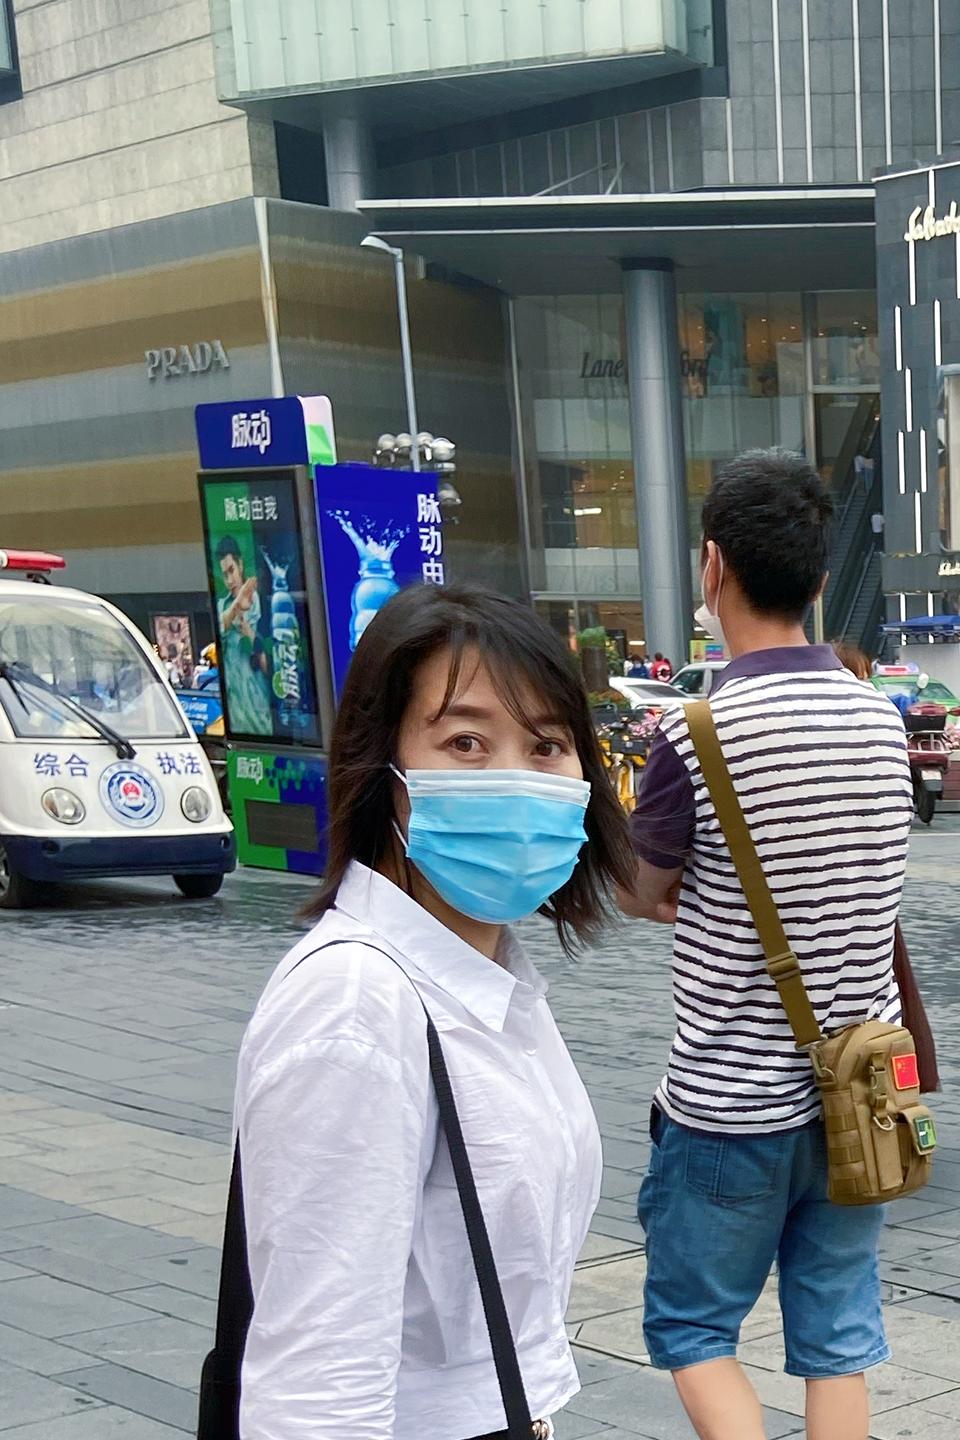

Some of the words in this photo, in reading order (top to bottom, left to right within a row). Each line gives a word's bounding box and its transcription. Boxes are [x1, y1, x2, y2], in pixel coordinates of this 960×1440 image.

[145, 339, 230, 379] PRADA
[580, 352, 624, 378] Lane
[231, 410, 271, 454] 脉动
[223, 496, 278, 522] 脉动由我
[34, 753, 89, 778] 综合
[155, 752, 205, 776] 执法
